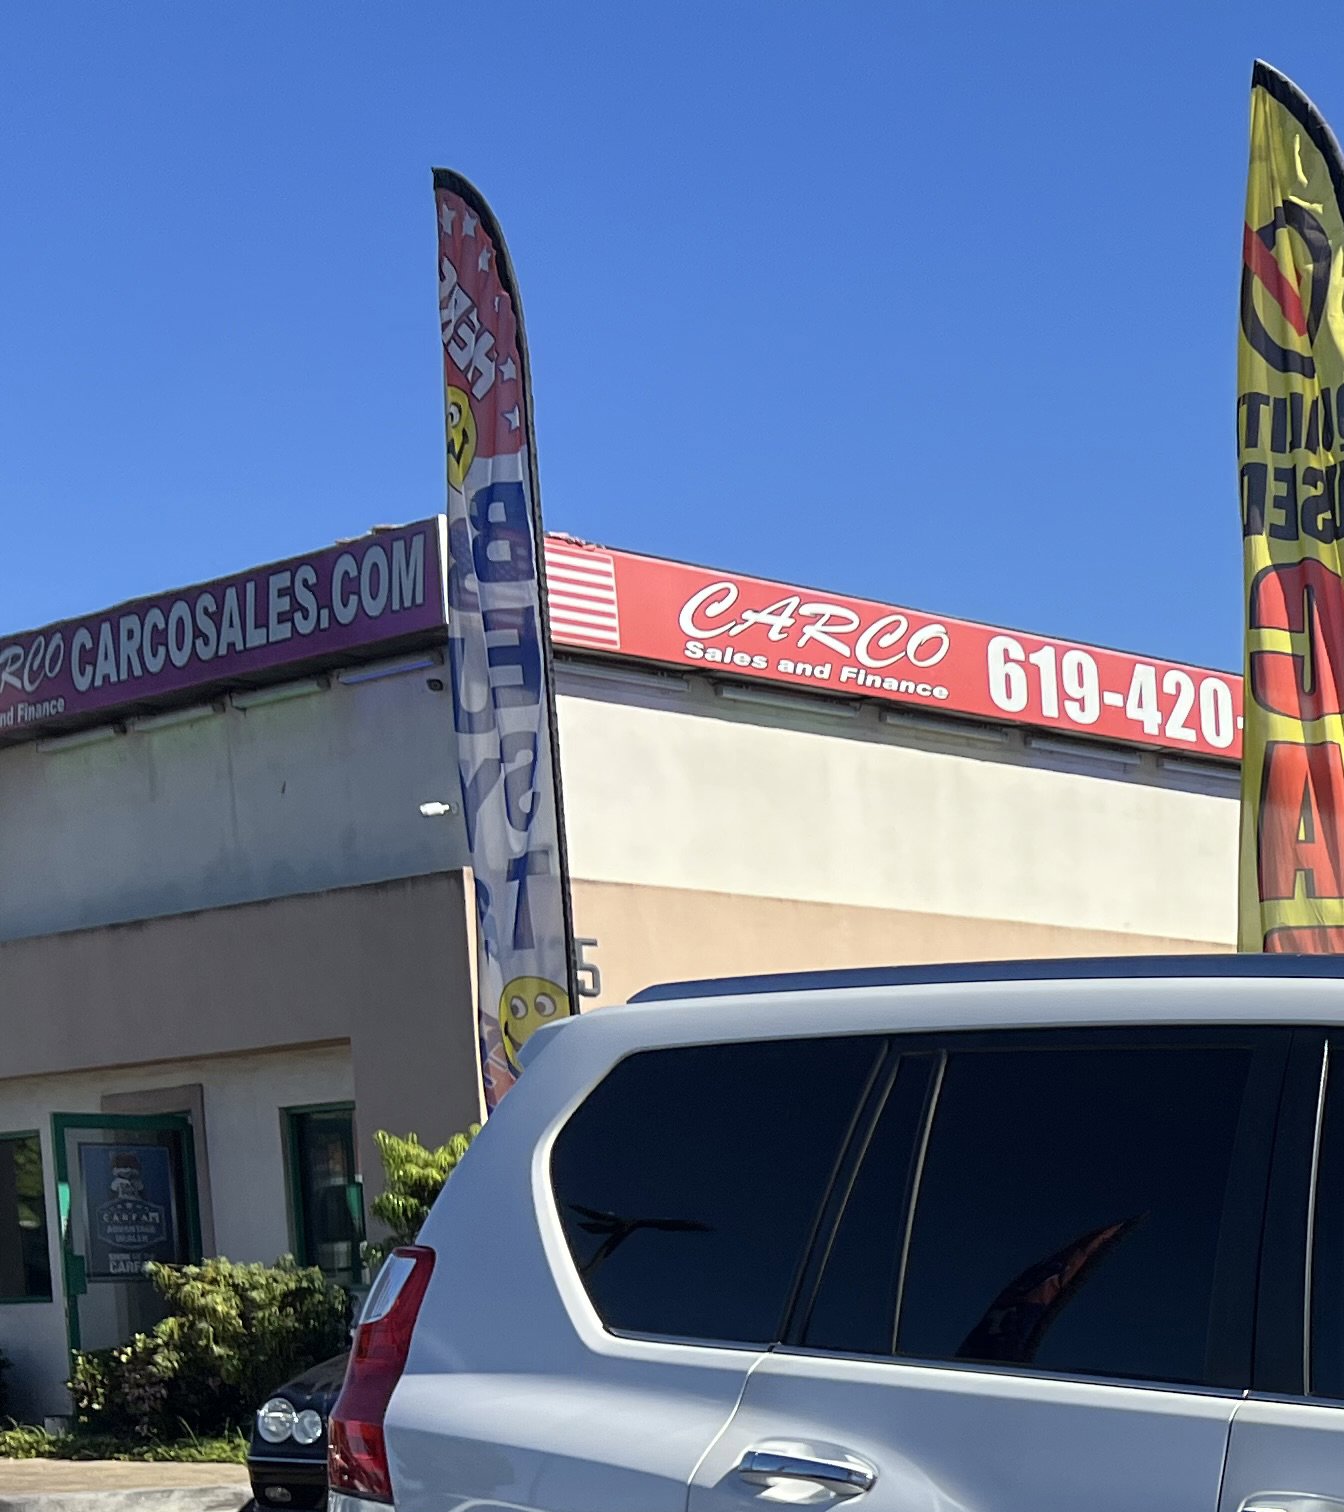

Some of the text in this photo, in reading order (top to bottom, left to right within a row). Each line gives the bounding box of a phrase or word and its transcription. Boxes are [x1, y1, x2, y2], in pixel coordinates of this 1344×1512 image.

[70, 530, 428, 693] CARCOSALES.COM
[677, 580, 951, 669] CARCO
[683, 639, 950, 701] Sales and Finance
[17, 697, 65, 724] Finance
